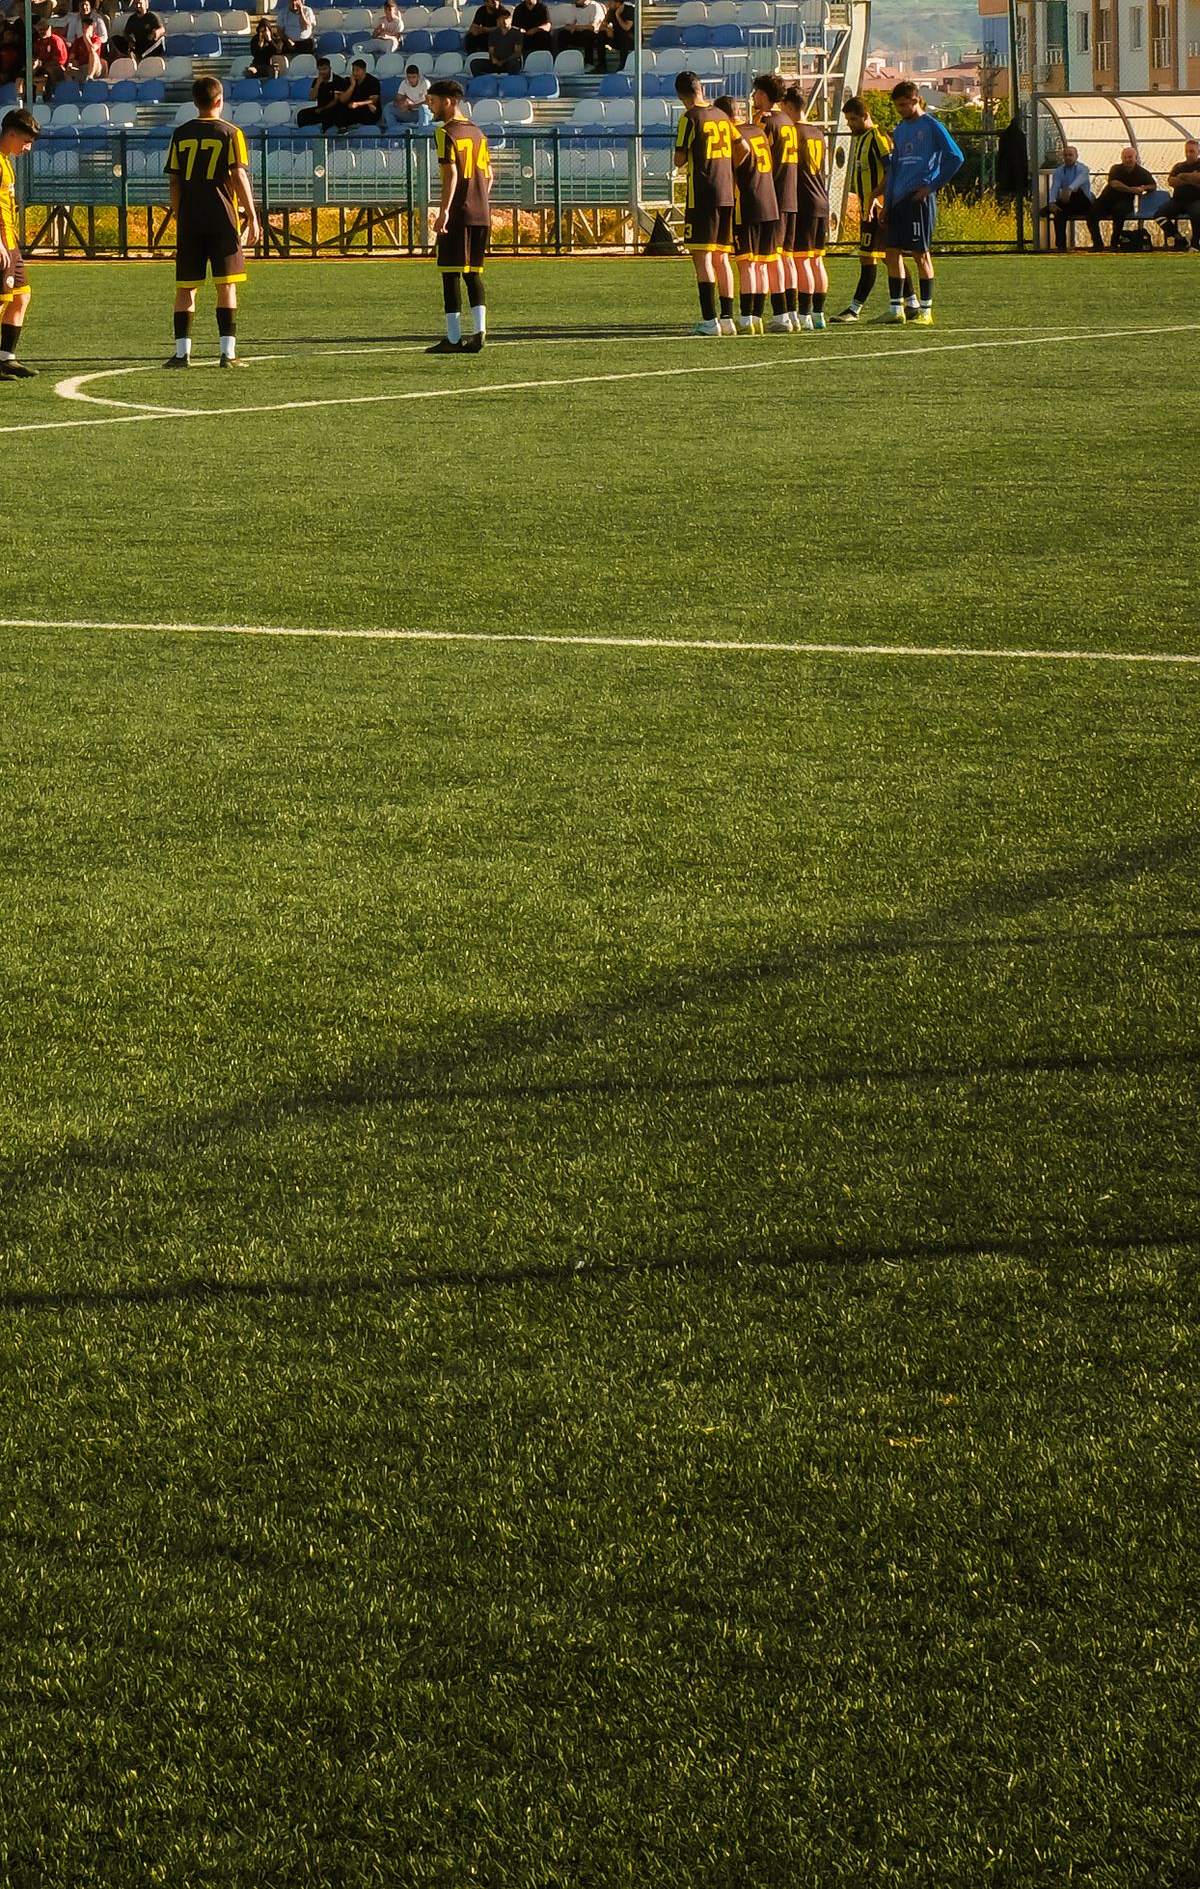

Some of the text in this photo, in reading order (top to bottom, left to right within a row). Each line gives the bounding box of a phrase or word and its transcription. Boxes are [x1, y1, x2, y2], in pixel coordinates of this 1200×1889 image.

[703, 120, 732, 159] 23
[750, 136, 772, 173] 5
[179, 138, 223, 181] 77
